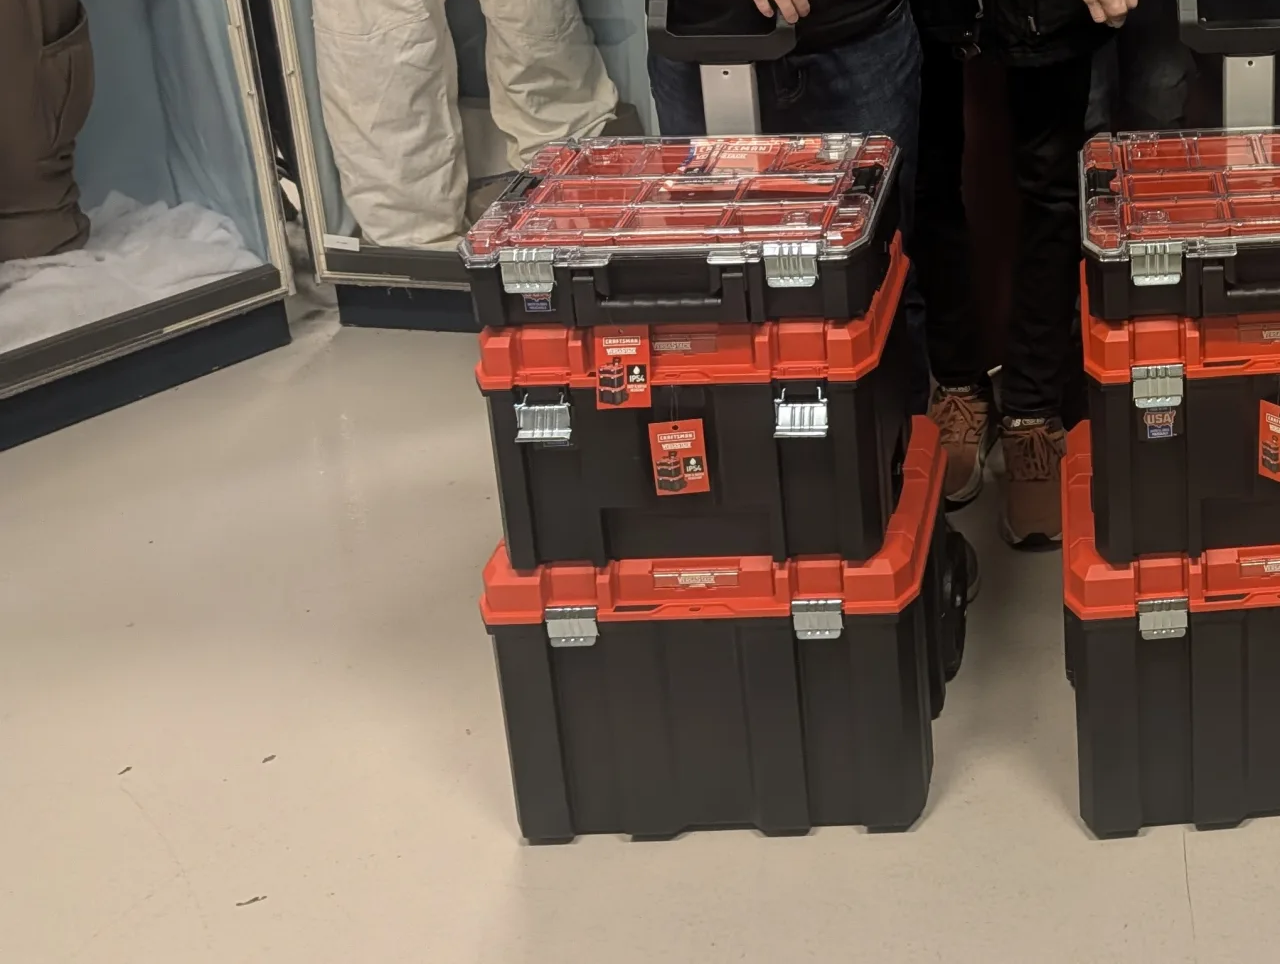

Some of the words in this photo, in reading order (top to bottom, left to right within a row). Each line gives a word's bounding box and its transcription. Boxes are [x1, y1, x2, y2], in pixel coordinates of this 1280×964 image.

[629, 374, 645, 383] IP54
[1146, 413, 1172, 424] USA
[659, 433, 693, 441] CRAFTSMAN
[686, 465, 702, 473] IP54
